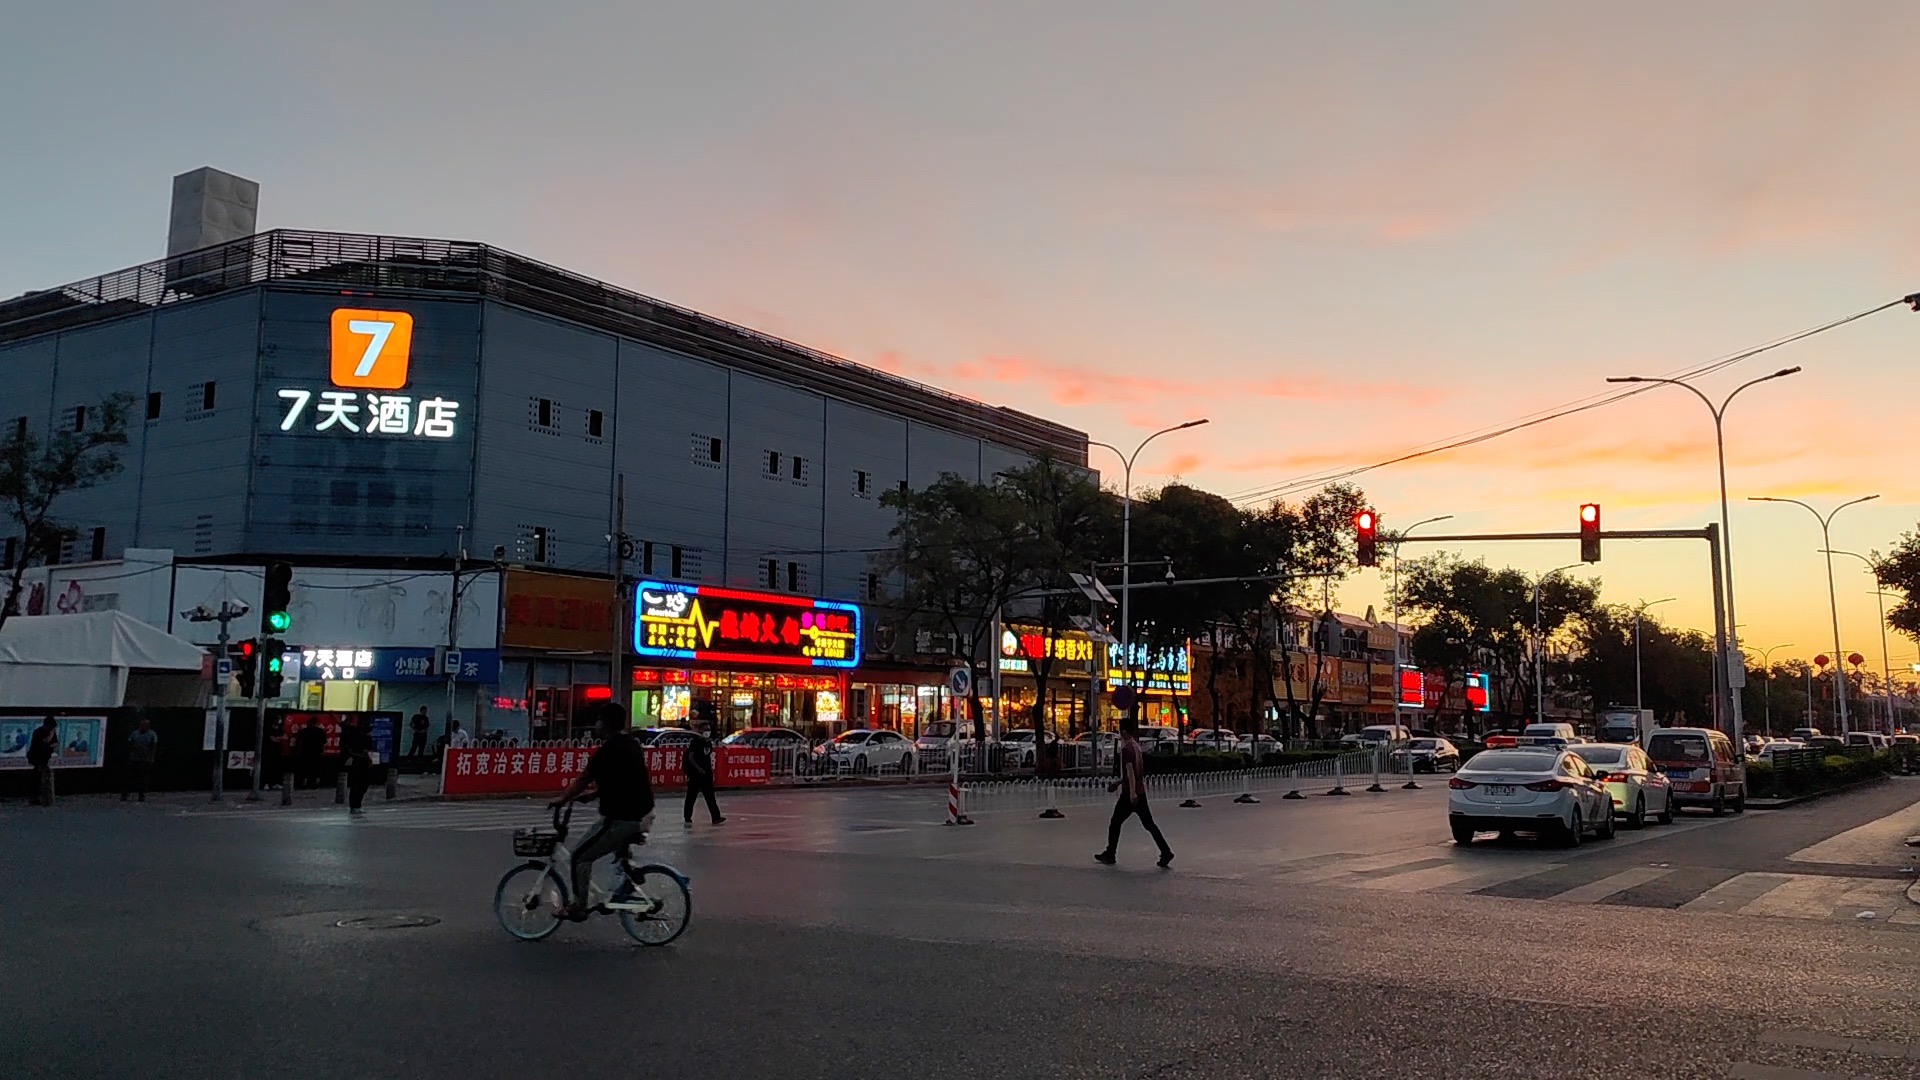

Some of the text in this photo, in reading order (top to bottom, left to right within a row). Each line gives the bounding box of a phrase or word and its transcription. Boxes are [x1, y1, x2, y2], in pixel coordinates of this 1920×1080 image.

[348, 319, 396, 377] 7
[278, 389, 460, 438] 7天酒店
[303, 650, 373, 667] 7天酒店
[321, 667, 355, 680] 入口
[464, 662, 479, 677] 茶
[456, 751, 590, 776] 拓宽治安信息渠道
